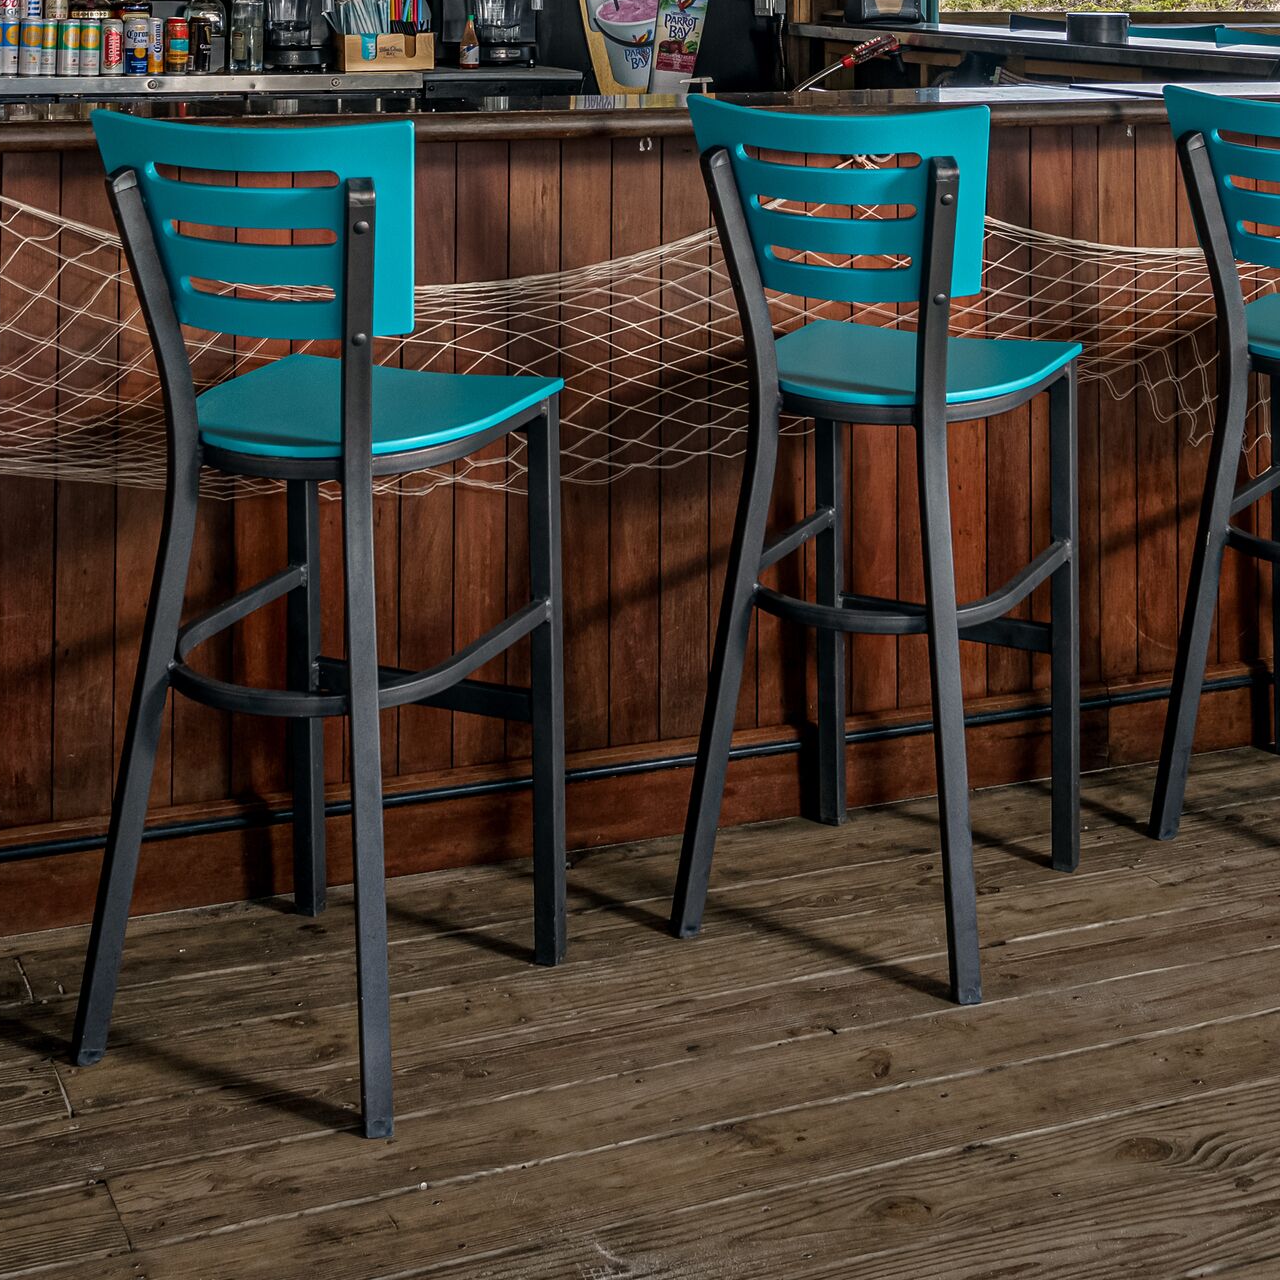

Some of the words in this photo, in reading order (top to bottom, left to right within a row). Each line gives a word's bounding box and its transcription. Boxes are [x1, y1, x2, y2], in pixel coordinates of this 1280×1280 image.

[664, 13, 700, 32] PARROT
[669, 24, 693, 39] BAY
[631, 56, 651, 70] BAY
